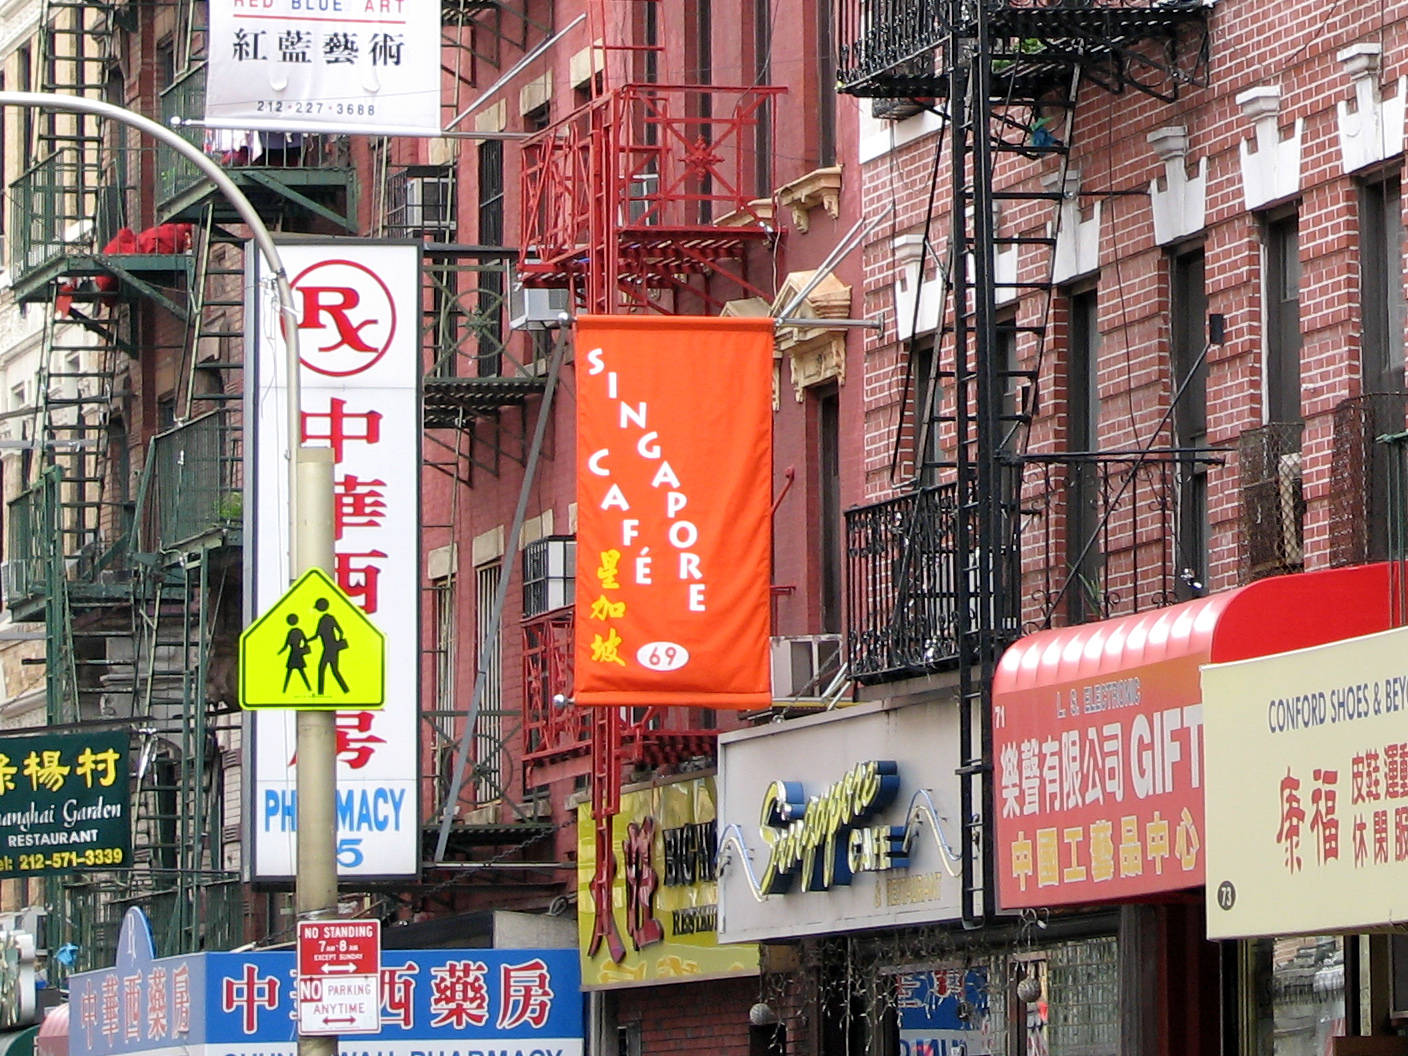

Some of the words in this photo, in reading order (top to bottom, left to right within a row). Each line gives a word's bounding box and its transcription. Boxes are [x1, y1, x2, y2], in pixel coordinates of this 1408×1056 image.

[364, 0, 405, 13] ART
[232, 27, 405, 66] 紅藍藝術
[588, 348, 706, 612] SINGAPORE
[588, 449, 652, 584] CAFÉ
[590, 550, 626, 666] 星加坡
[649, 646, 677, 667] 69
[1083, 677, 1141, 714] ELECTRONIC
[1268, 691, 1326, 733] CONFORD
[1331, 682, 1369, 723] SHOES
[1373, 682, 1381, 715] &
[995, 705, 1005, 728] 71
[1130, 703, 1204, 799] GIFT
[63, 796, 122, 827] Garden
[265, 787, 406, 832] PHMACY
[8, 829, 98, 848] RESTAURANT
[19, 848, 123, 871] 212-571-3339
[1221, 886, 1233, 904] 73
[305, 927, 319, 939] NO
[324, 926, 373, 938] STANDING
[222, 960, 555, 1033] 中西藥房
[300, 980, 322, 1000] NO
[327, 984, 372, 997] PARKING
[313, 1002, 365, 1015] ANYTIME
